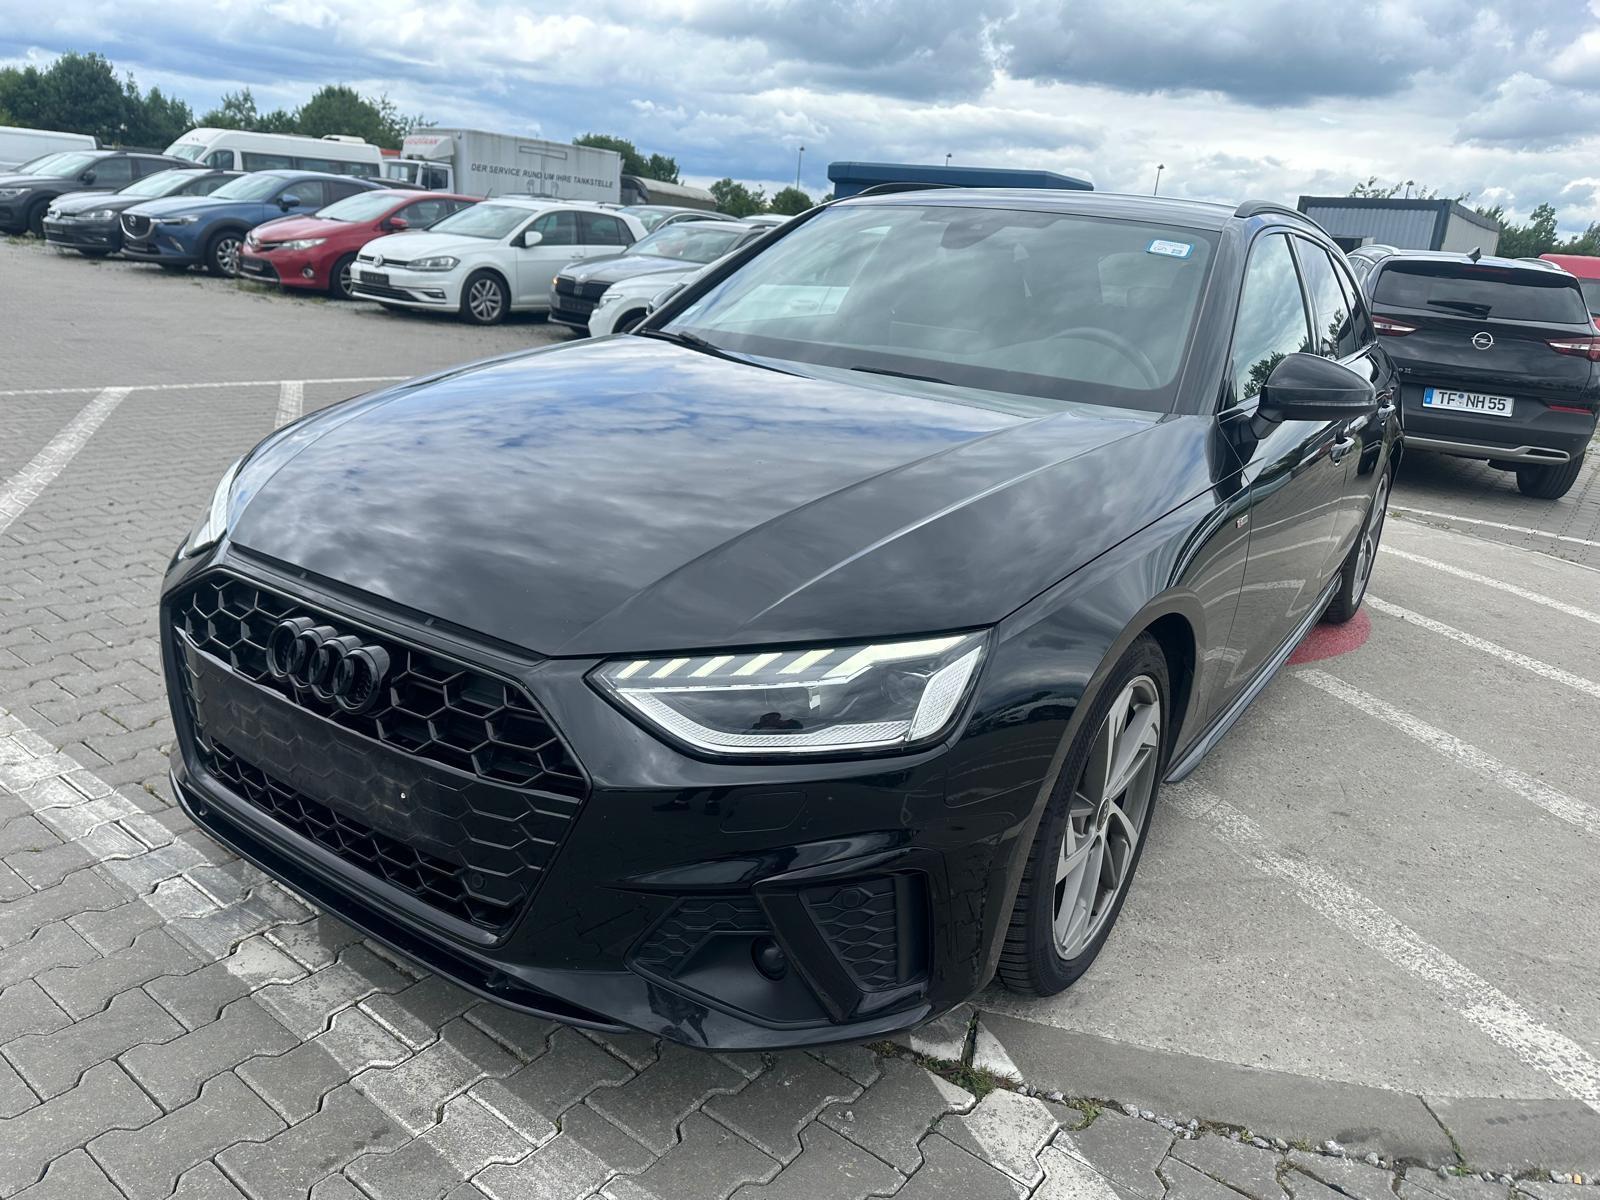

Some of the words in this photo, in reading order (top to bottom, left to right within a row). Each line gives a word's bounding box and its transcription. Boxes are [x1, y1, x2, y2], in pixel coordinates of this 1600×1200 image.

[471, 163, 487, 172] DER
[489, 165, 521, 177] SERVICE
[522, 169, 543, 180] RUND
[543, 172, 554, 181] UM
[556, 174, 571, 184] IHRE
[573, 175, 613, 188] TANKSTELLE
